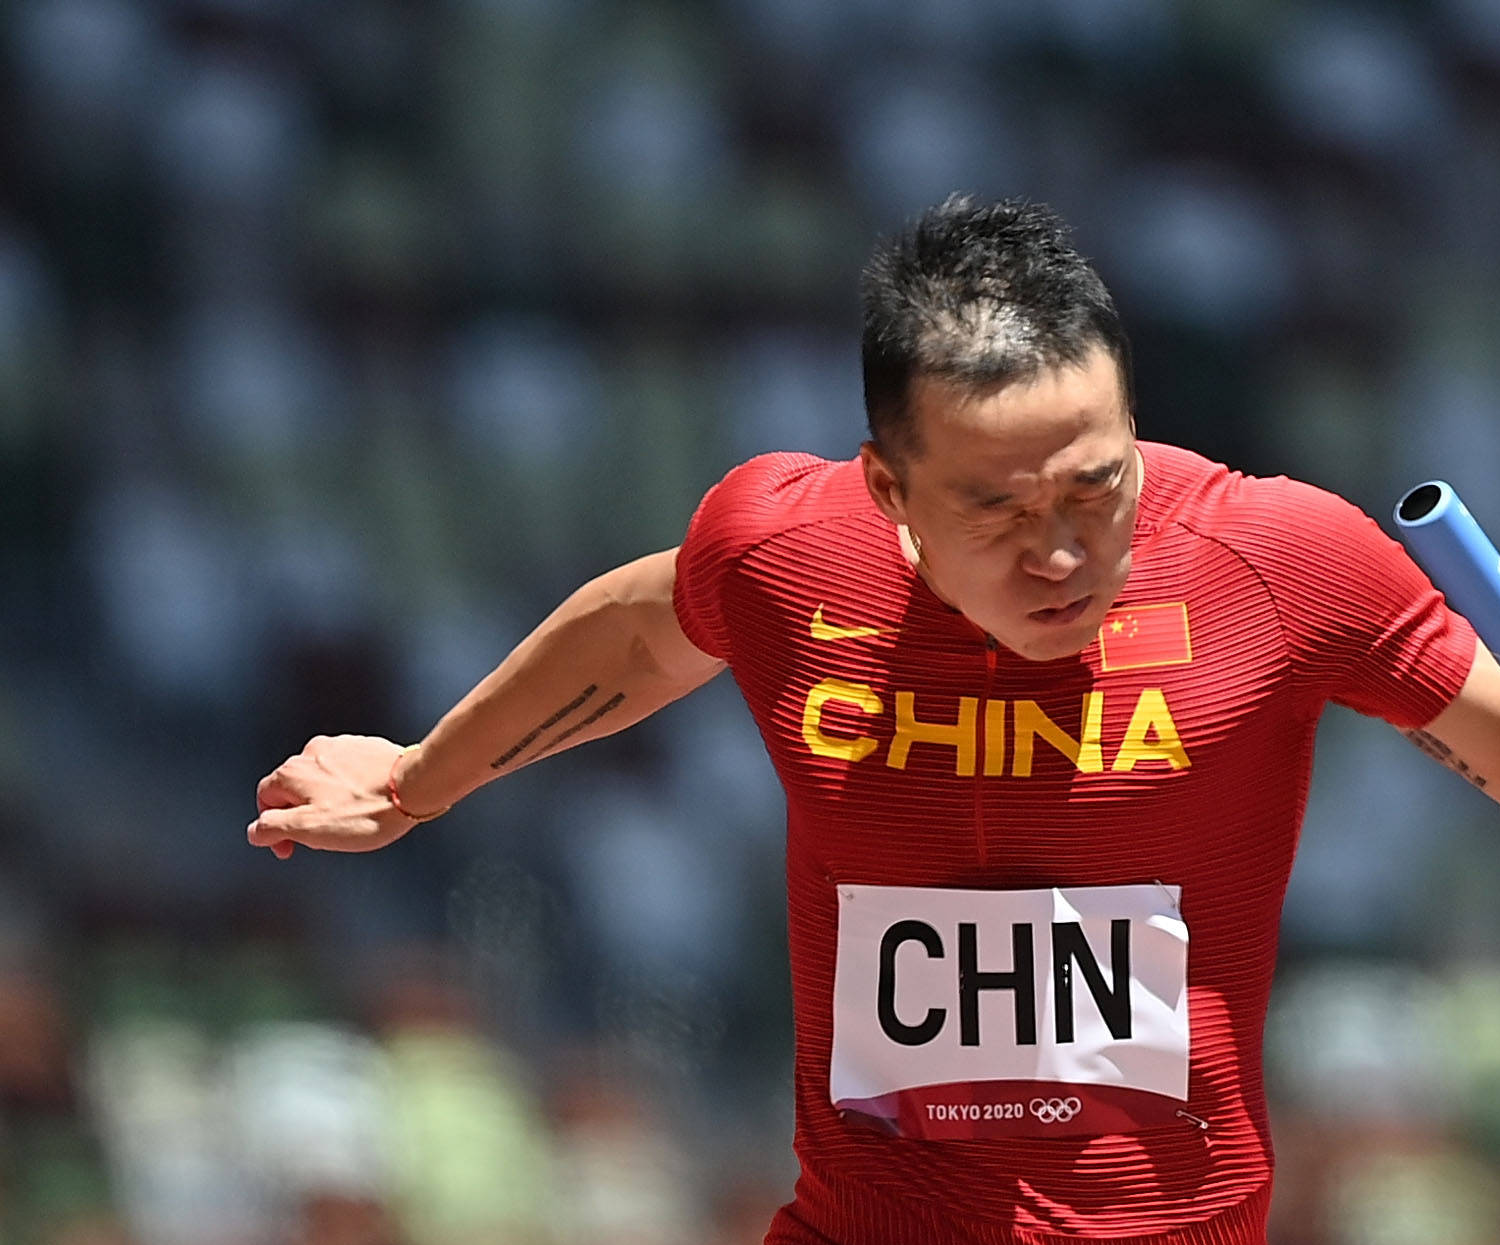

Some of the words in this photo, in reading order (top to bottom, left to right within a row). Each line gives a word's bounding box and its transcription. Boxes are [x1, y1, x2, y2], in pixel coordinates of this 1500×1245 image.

[802, 677, 1191, 777] CHINA
[877, 919, 1132, 1046] CHN
[926, 1104, 980, 1121] TOKYO
[983, 1103, 1024, 1120] 2020
